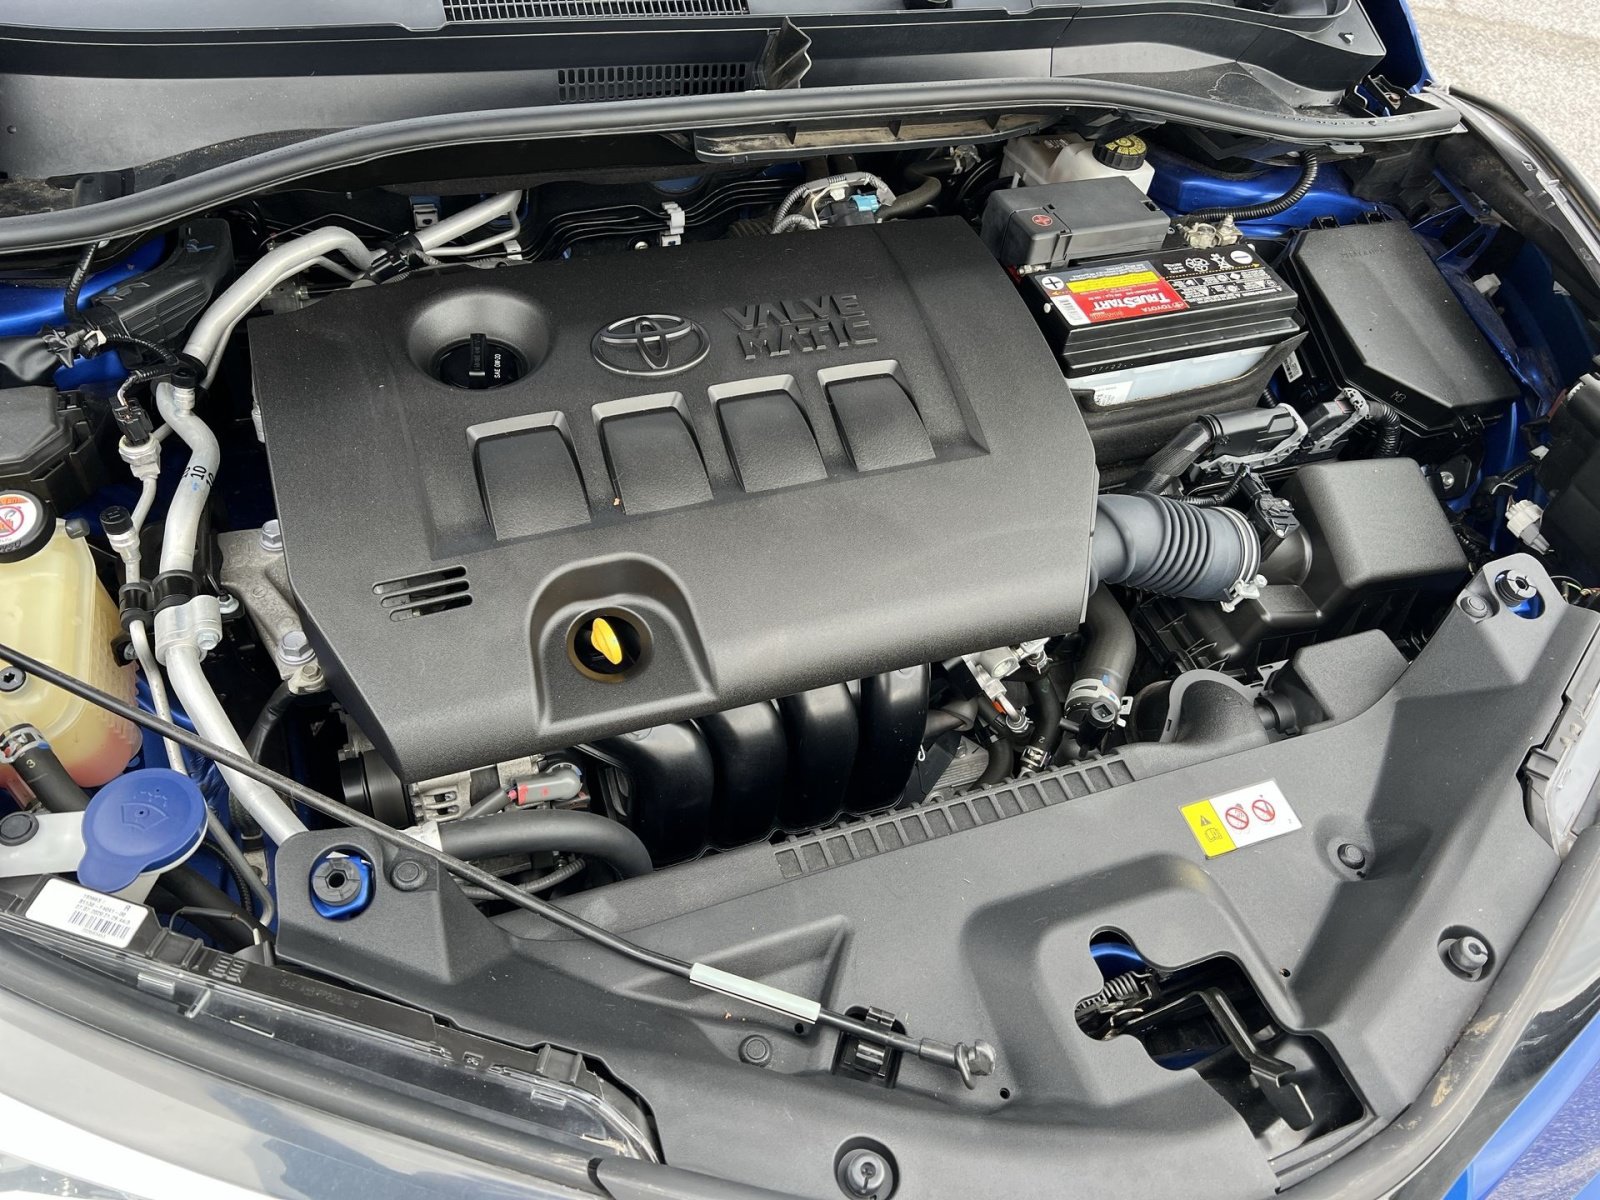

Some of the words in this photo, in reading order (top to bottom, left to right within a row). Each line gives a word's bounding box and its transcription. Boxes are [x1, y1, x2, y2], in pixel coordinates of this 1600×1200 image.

[722, 294, 865, 331] VALVE
[1141, 302, 1174, 313] TOYOTA
[737, 317, 877, 359] MATIC
[191, 466, 206, 480] 10
[26, 759, 36, 768] 3
